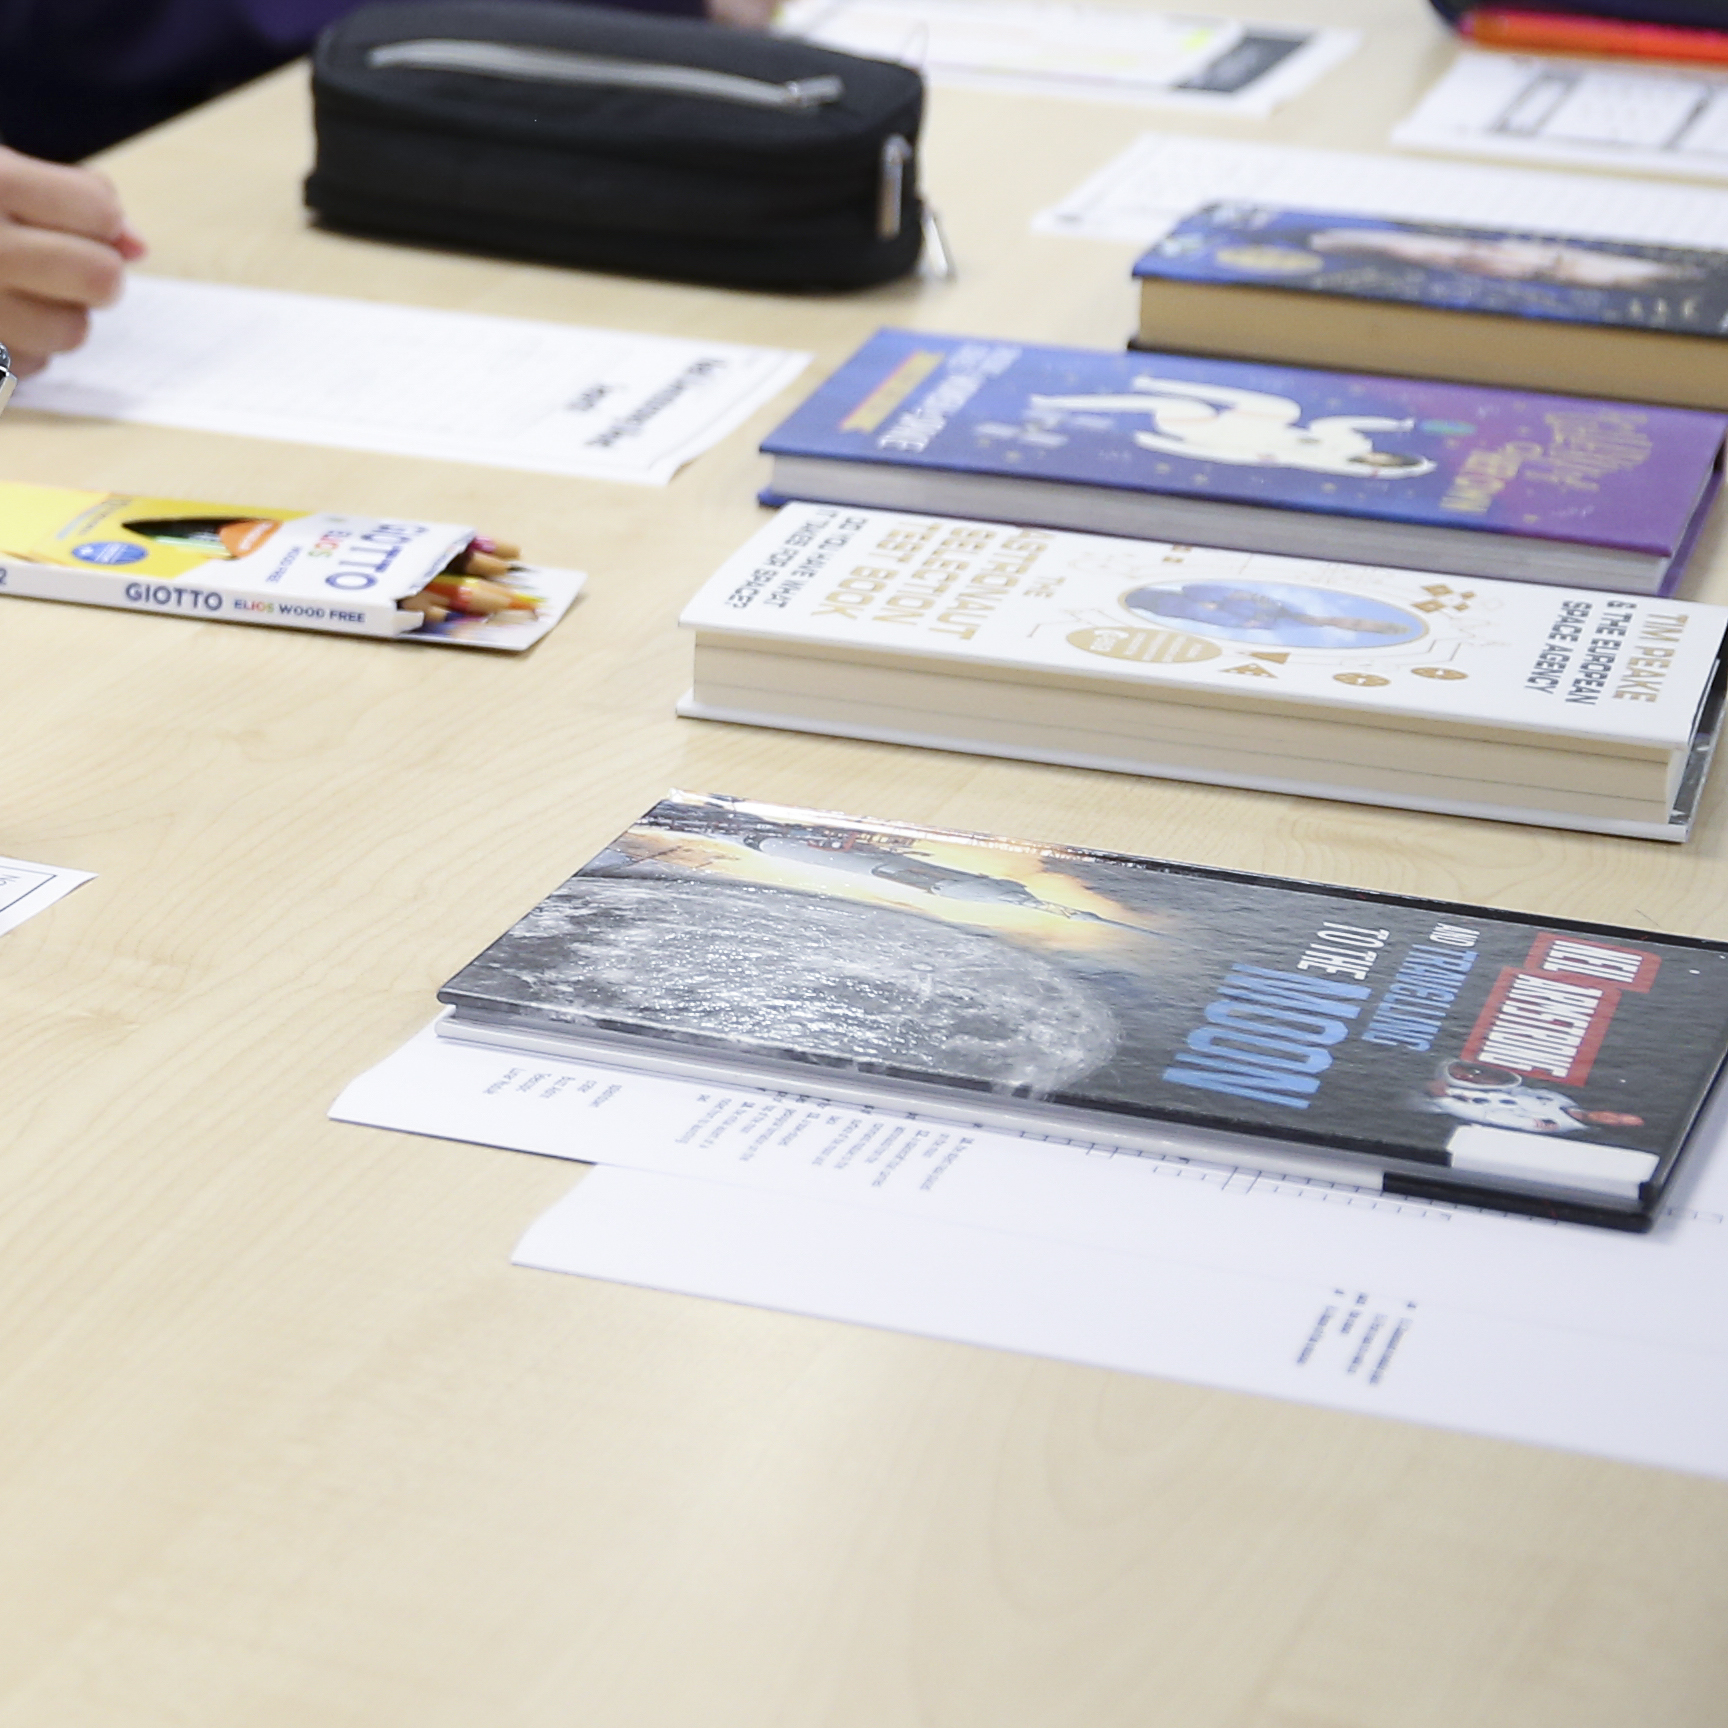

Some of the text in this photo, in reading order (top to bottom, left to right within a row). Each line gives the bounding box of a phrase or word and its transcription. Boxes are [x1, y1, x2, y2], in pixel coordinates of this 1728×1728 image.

[125, 582, 366, 624] GIOTTO ELIOS WOOD FREE
[810, 565, 899, 621] BOOK
[872, 526, 998, 626] SELECTION
[928, 527, 1056, 641] ASTRONAUT
[1023, 575, 1066, 599] THE
[1524, 600, 1592, 694] SPACE AGENCY
[1595, 612, 1633, 637] THE
[1565, 638, 1622, 705] EUROPEAN
[1612, 614, 1689, 703] TIM PEAKE
[1297, 921, 1391, 980] TO THE
[1429, 922, 1481, 948] AND
[1543, 940, 1644, 983] NEIL
[1162, 962, 1372, 1109] MOON
[1477, 973, 1603, 1078] ARMSTRONG
